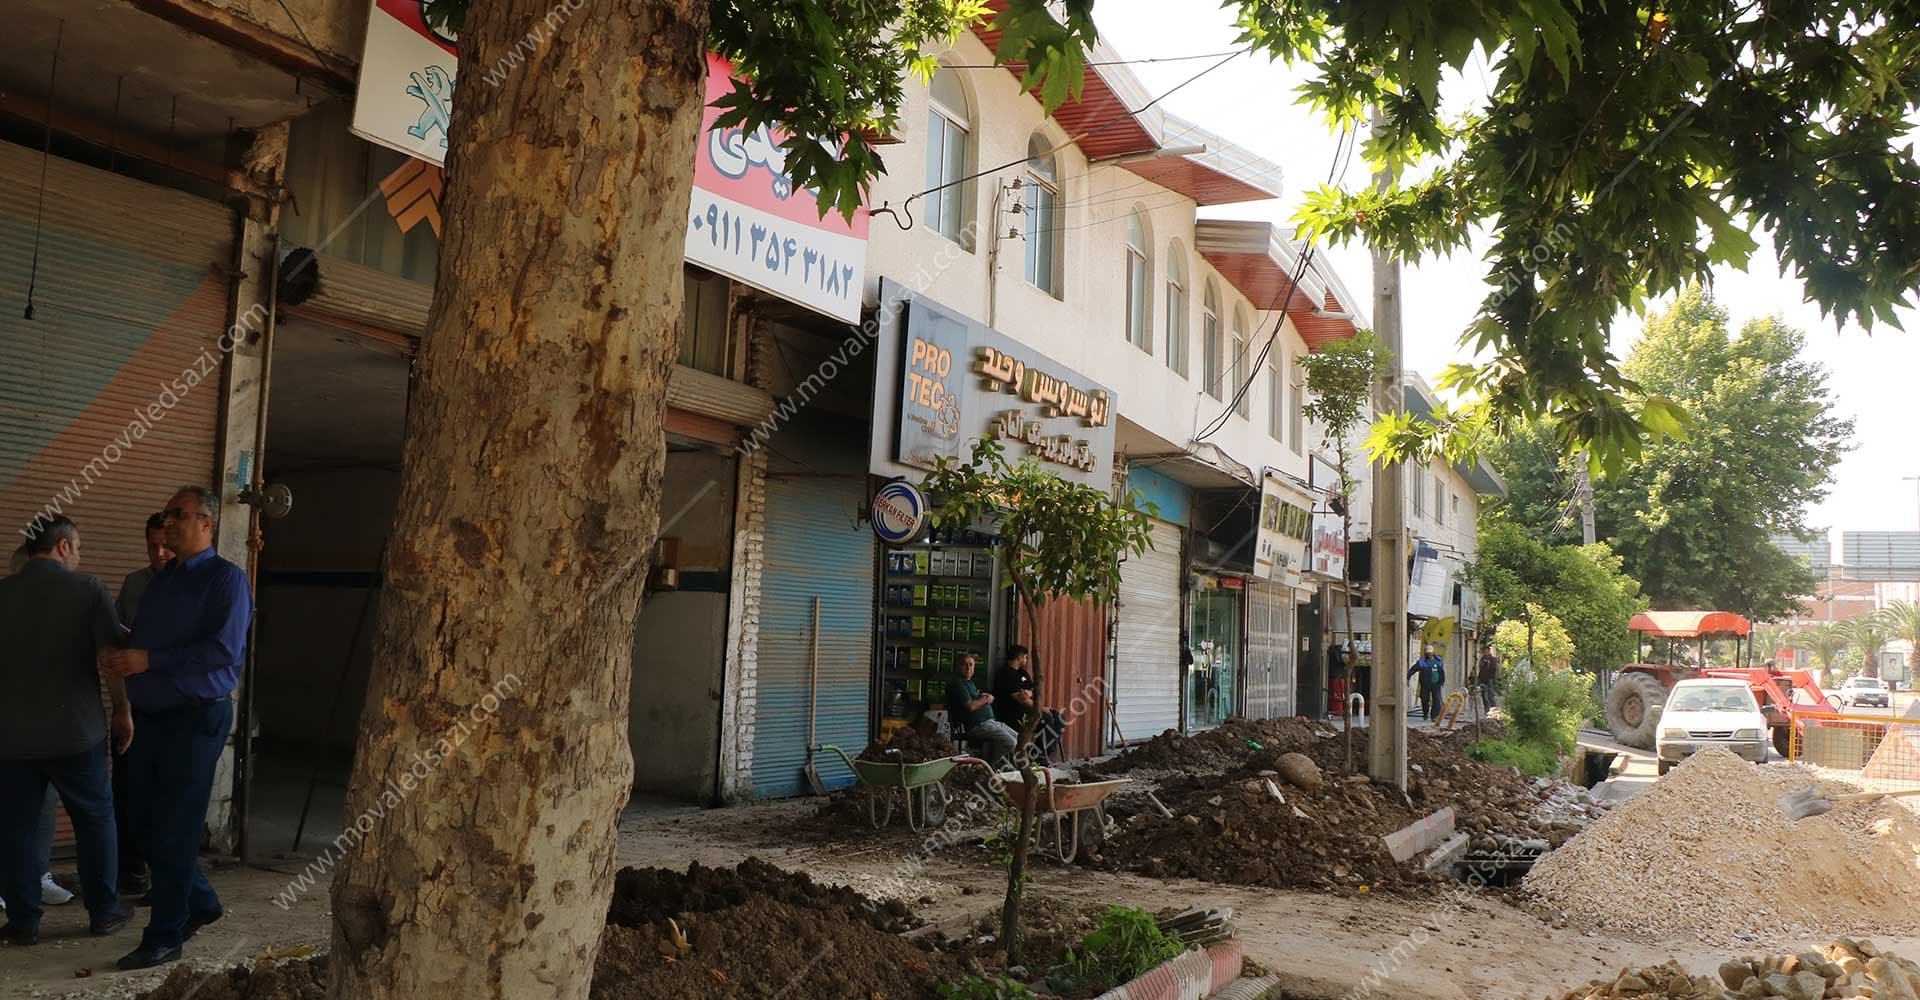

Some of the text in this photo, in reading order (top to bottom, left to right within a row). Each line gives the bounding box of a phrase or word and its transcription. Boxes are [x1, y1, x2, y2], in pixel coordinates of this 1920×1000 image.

[911, 337, 952, 378] PRO
[979, 347, 1025, 393] وحید
[909, 371, 945, 410] TEC
[1029, 369, 1089, 418] سرویس
